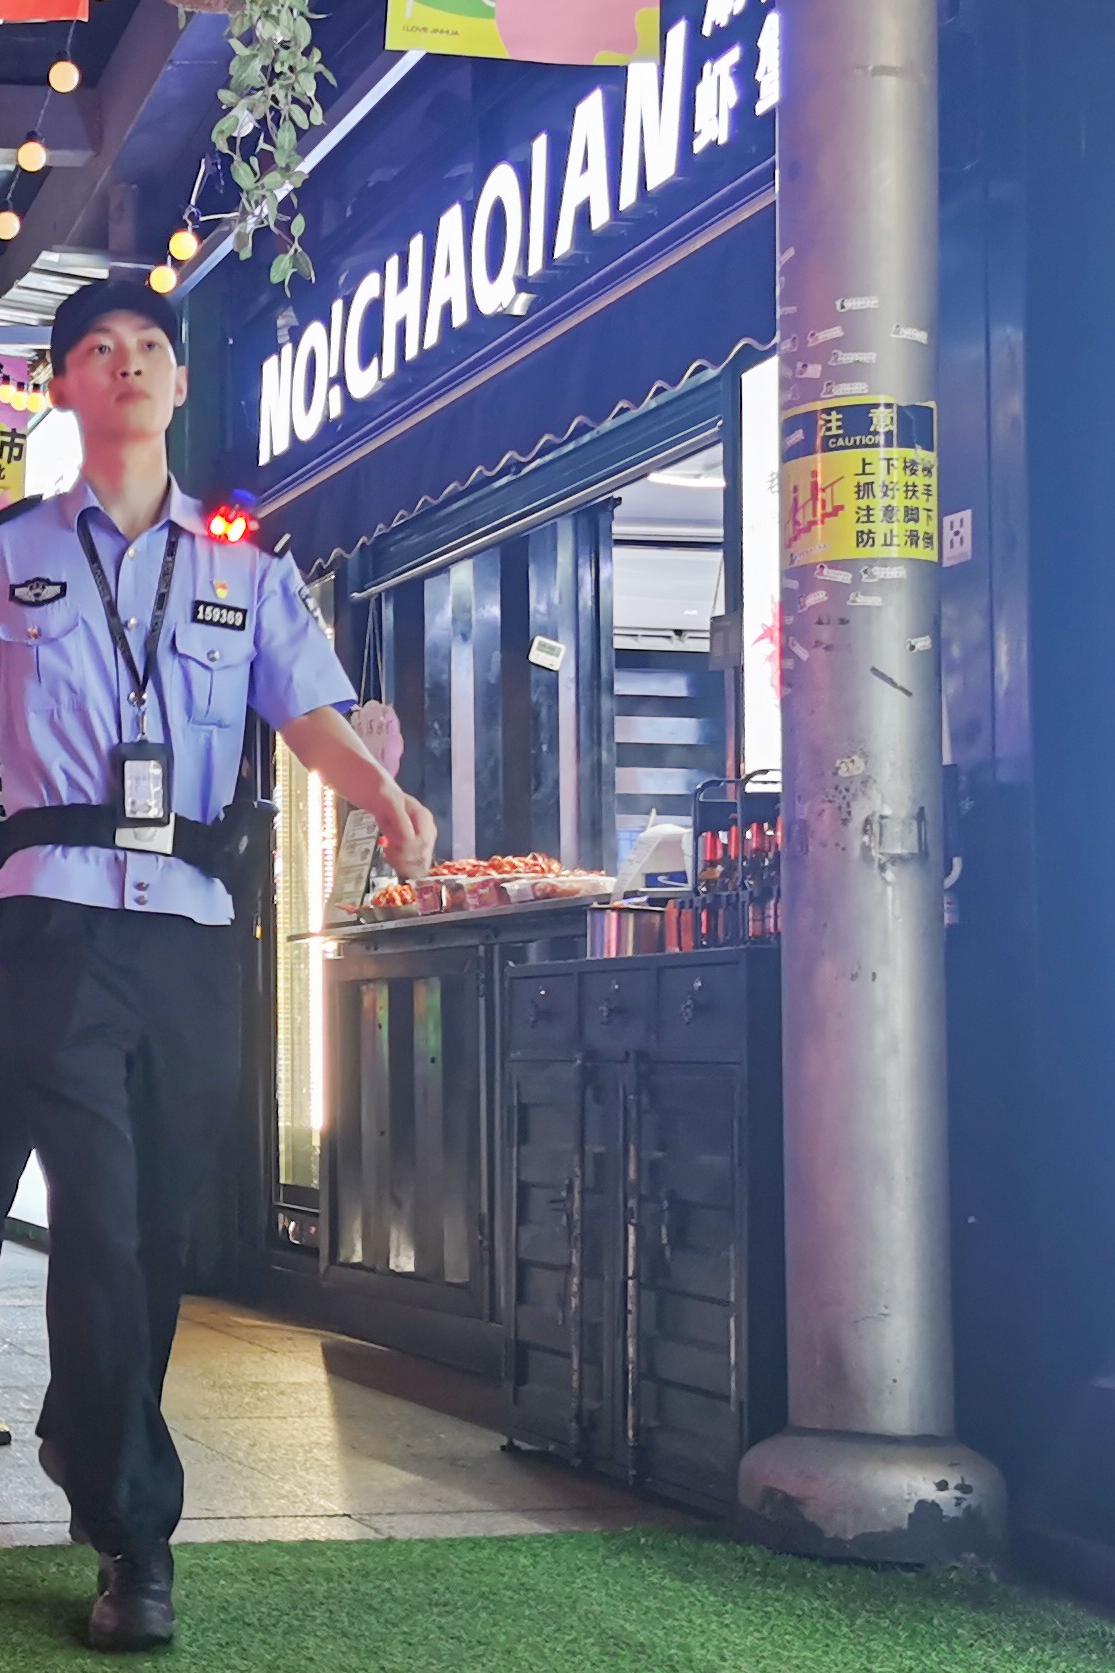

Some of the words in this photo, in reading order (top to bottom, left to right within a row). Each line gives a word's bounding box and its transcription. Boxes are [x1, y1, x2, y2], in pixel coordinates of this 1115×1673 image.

[820, 405, 895, 437] 注意
[854, 480, 934, 503] 抓好扶手
[854, 504, 934, 527] 注意脚下
[855, 528, 934, 550] 防止滑倒
